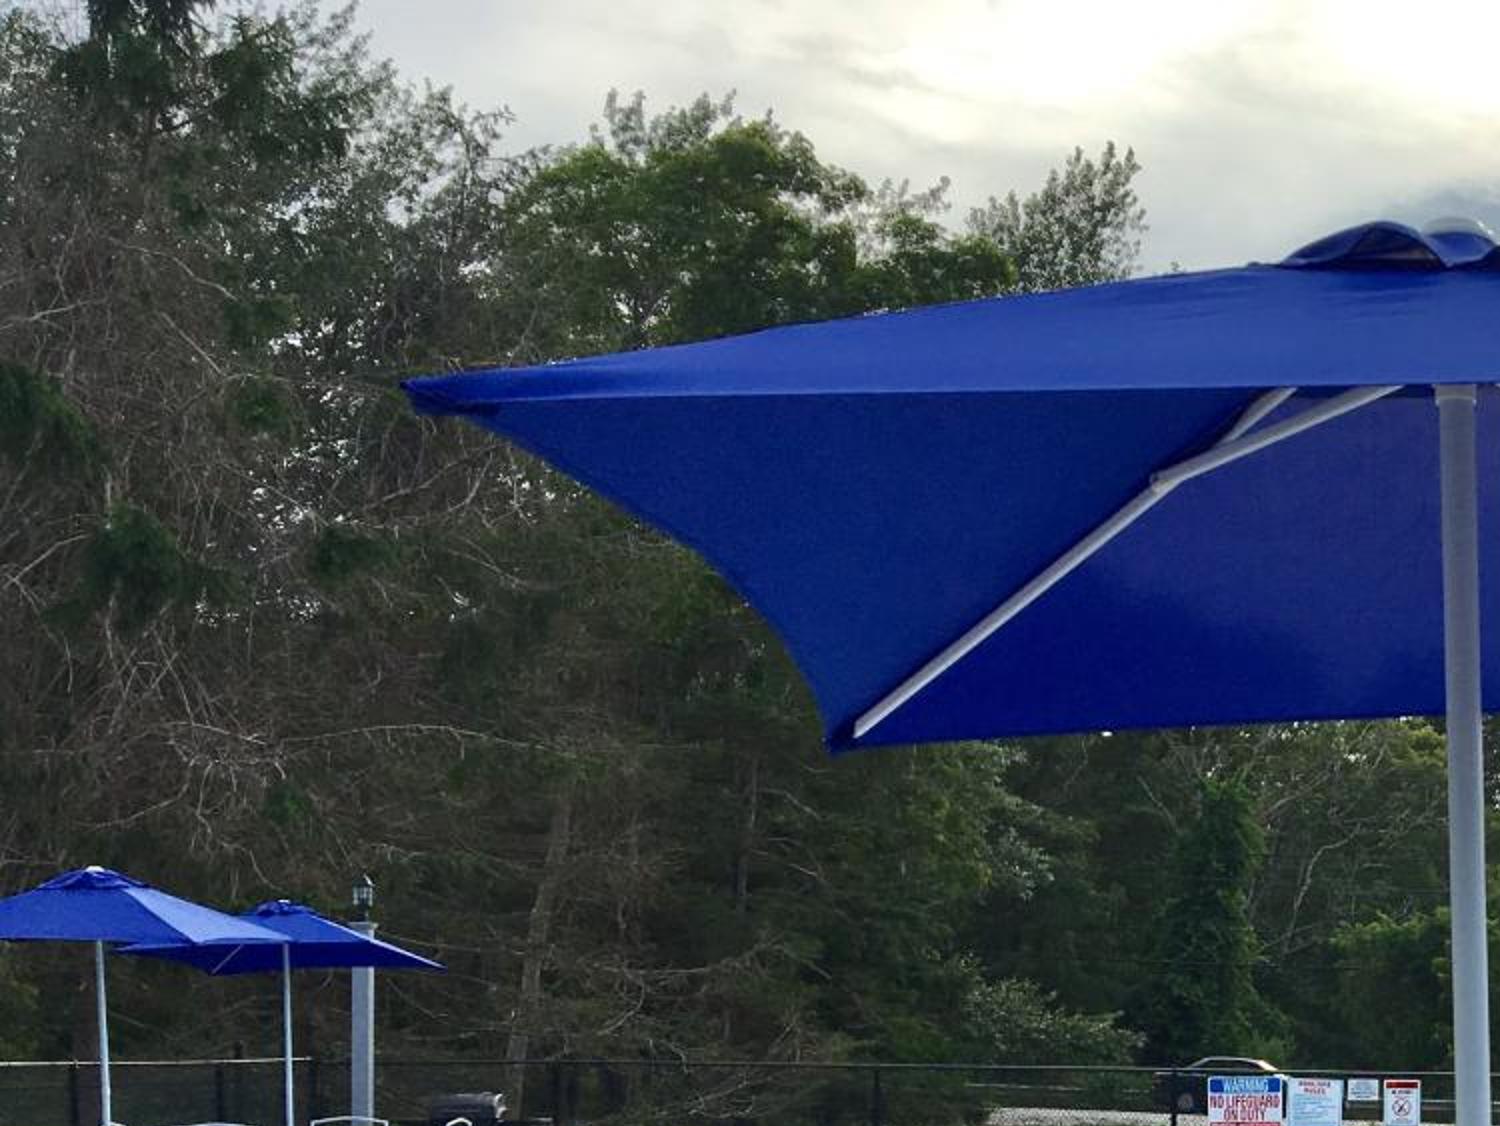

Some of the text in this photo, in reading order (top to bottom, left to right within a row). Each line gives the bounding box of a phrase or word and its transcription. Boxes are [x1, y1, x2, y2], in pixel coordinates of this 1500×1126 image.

[1209, 1095, 1280, 1108] NO LIFEGUARD
[1223, 1109, 1266, 1120] ON DUTY
